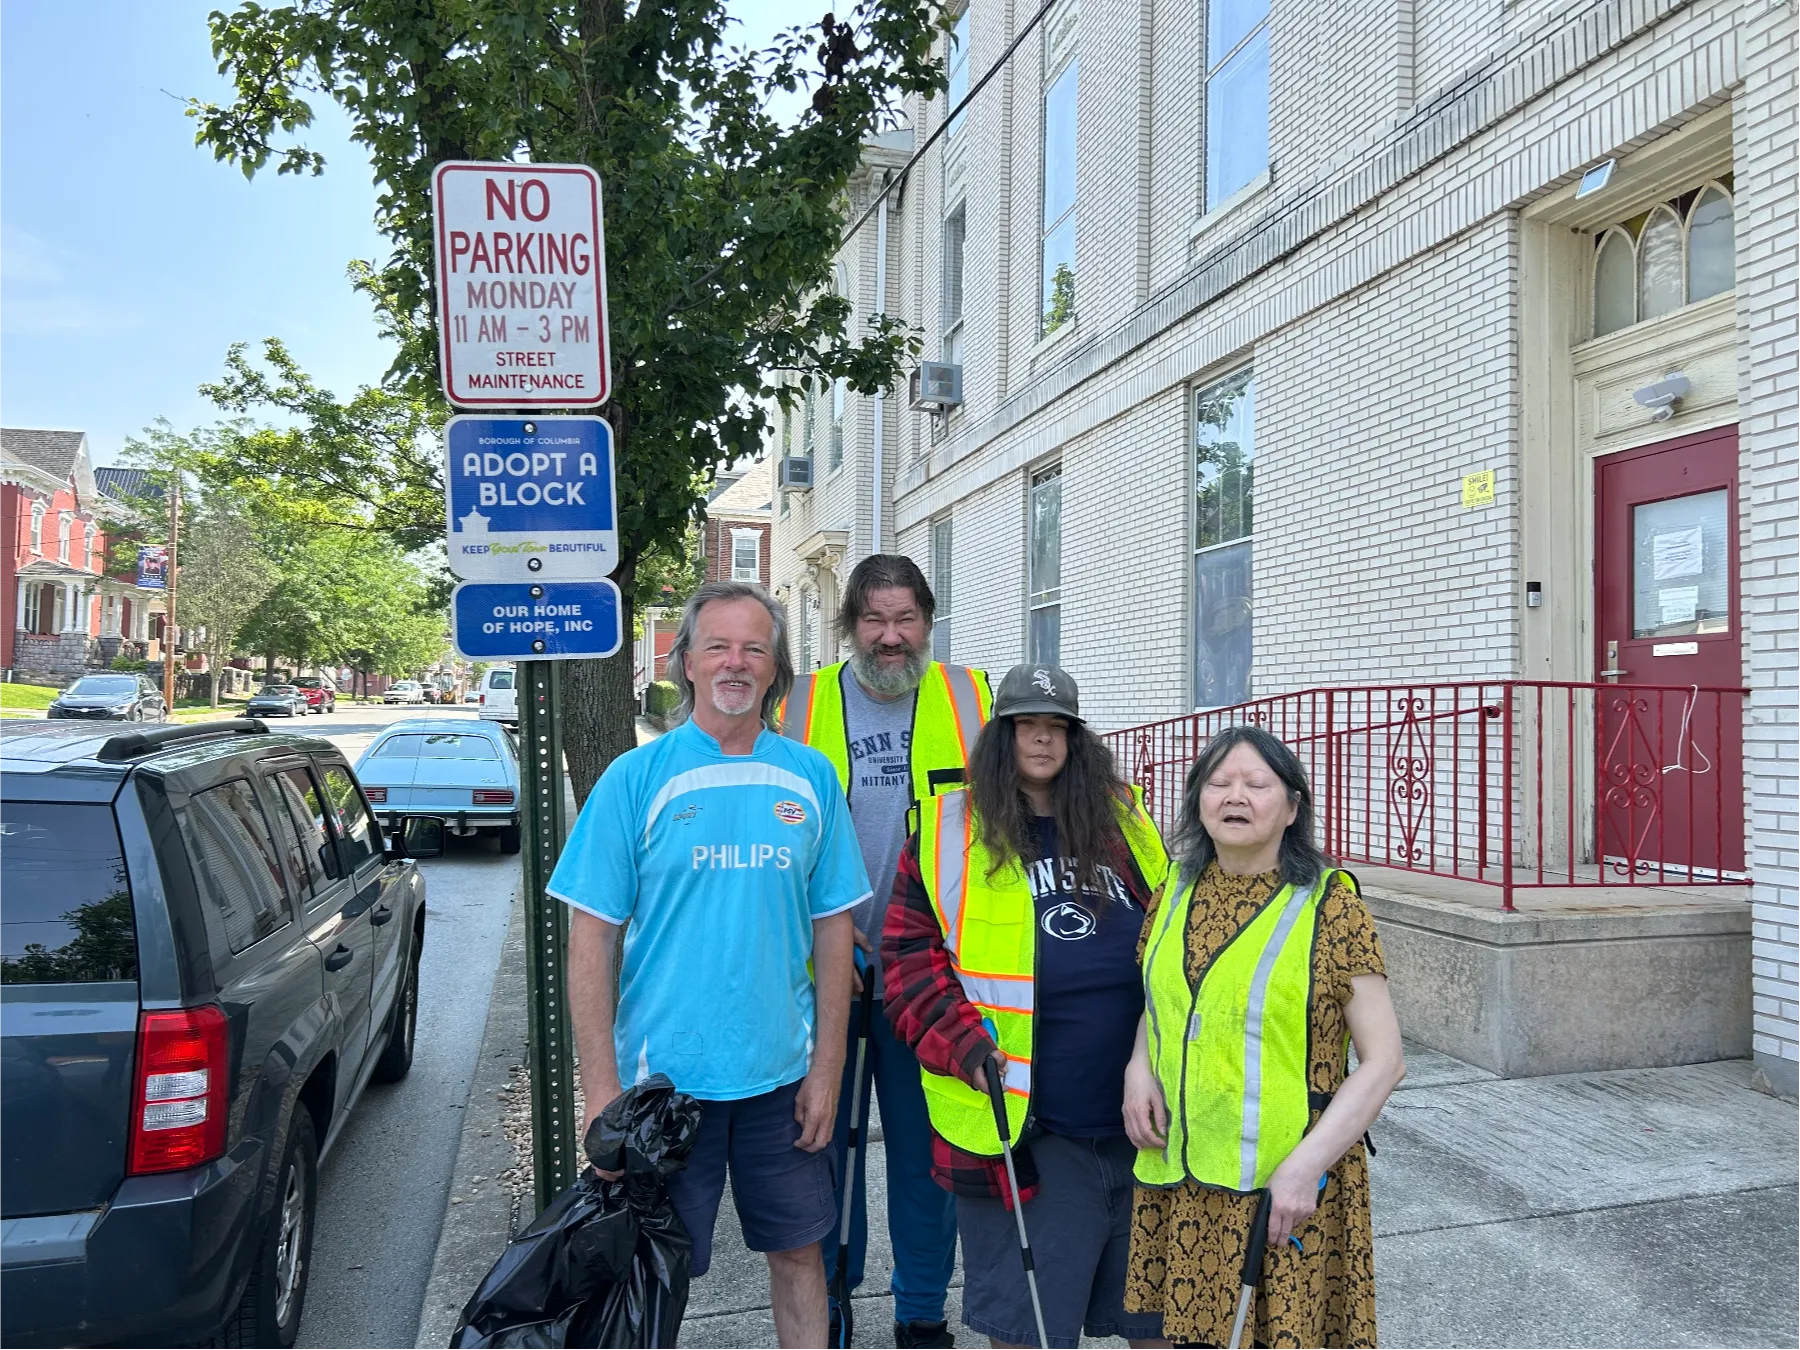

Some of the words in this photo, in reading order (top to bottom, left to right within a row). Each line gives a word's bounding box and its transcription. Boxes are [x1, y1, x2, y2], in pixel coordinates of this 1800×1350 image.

[485, 178, 550, 222] NO
[450, 231, 590, 276] PARKING
[467, 280, 577, 310] MONDAY
[454, 314, 468, 343] 11
[478, 315, 507, 343] AM
[538, 314, 550, 343] 3
[562, 315, 590, 343] PM
[496, 352, 556, 367] STREET
[468, 374, 585, 389] MAINTENANCE
[478, 437, 521, 445] BOROUGH
[523, 437, 535, 445] OF
[538, 437, 581, 445] COLUMBIA
[463, 452, 567, 477] ADOPT
[579, 452, 597, 476] A
[479, 481, 587, 506] BLOCK
[462, 545, 490, 555] KEEP
[549, 543, 606, 553] BEAUTIFUL
[492, 605, 529, 618] OUR
[534, 604, 582, 617] HOME
[482, 622, 505, 634] OF
[510, 621, 560, 635] HOPE,
[564, 619, 594, 632] INC
[861, 774, 905, 787] NITTANY
[692, 843, 792, 870] PHILIPS
